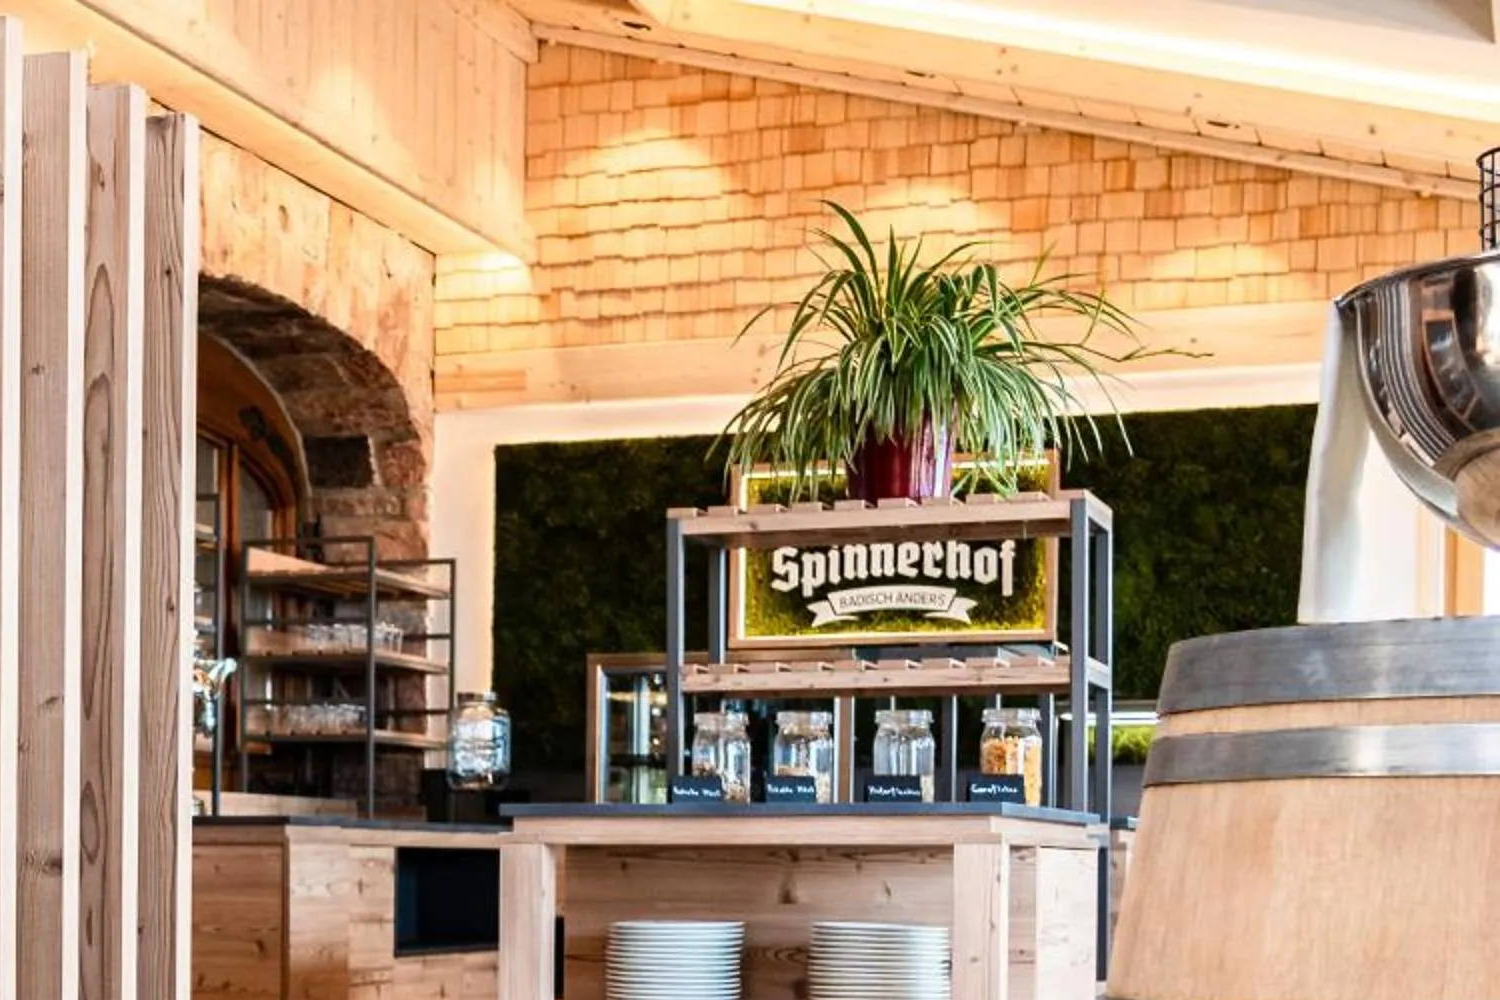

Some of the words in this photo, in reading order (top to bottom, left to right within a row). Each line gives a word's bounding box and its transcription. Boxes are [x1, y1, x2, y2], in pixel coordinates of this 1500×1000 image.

[770, 539, 1016, 598] Spinnerhof
[839, 592, 893, 609] BADISCH
[895, 591, 947, 607] ANDERS
